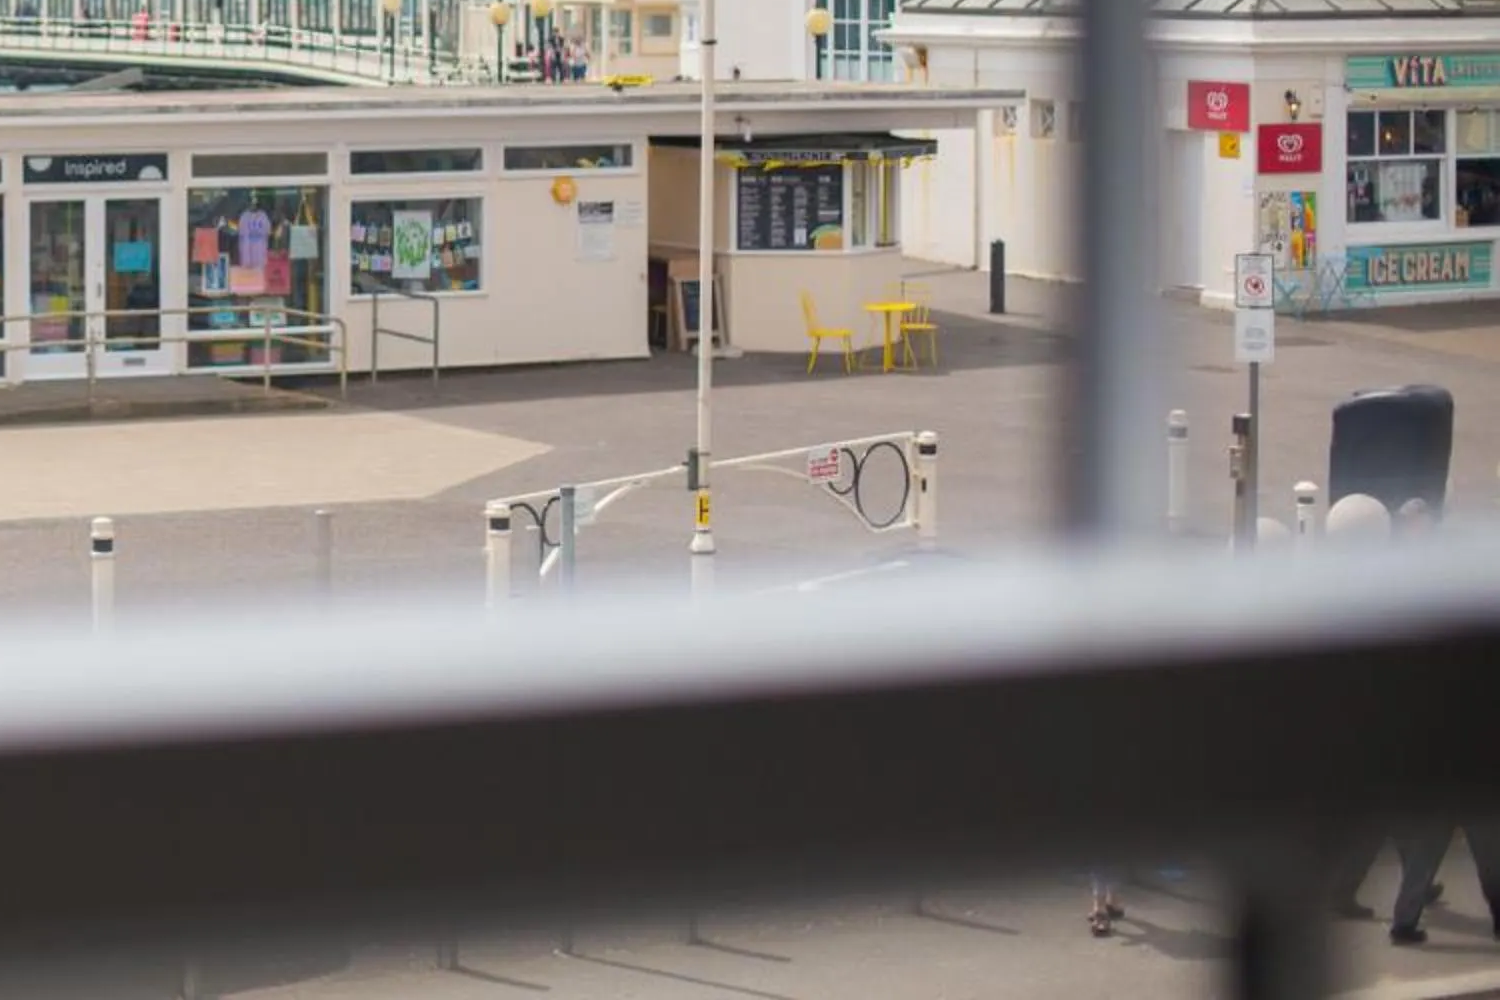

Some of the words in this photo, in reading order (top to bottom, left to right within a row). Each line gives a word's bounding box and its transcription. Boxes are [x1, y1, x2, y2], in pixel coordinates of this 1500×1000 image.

[64, 159, 127, 177] Inspired
[1368, 252, 1399, 284] ICE
[1403, 250, 1470, 282] CREAM
